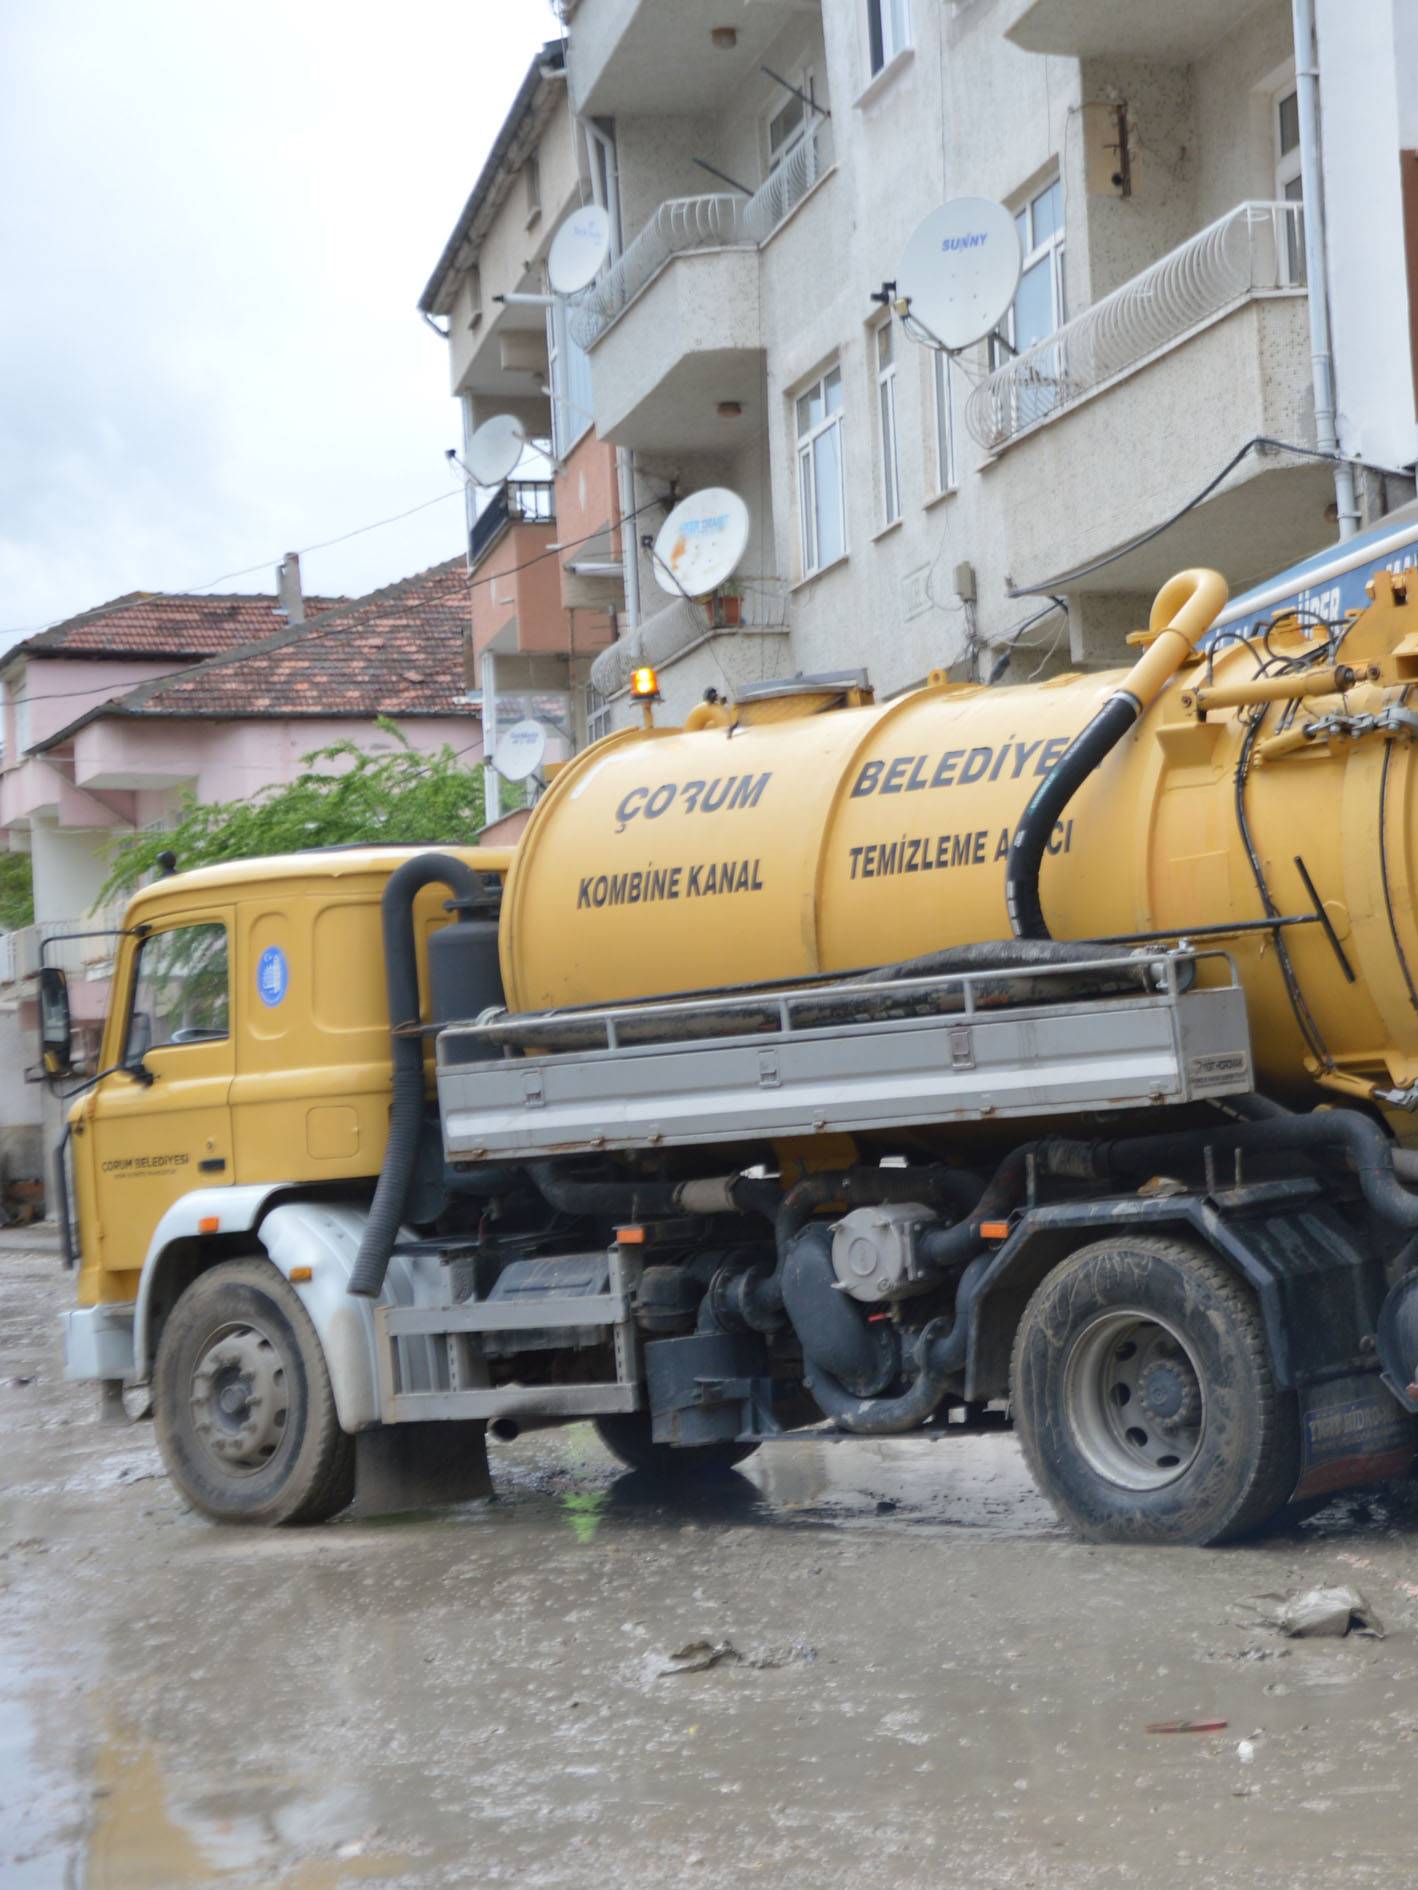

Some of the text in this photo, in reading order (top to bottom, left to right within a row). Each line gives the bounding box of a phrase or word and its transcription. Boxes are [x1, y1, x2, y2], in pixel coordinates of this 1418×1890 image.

[614, 733, 1100, 834] ÇORUM BELEDİYE
[577, 819, 1074, 909] KOMBİNE KANAL TEMİZLEME ACI
